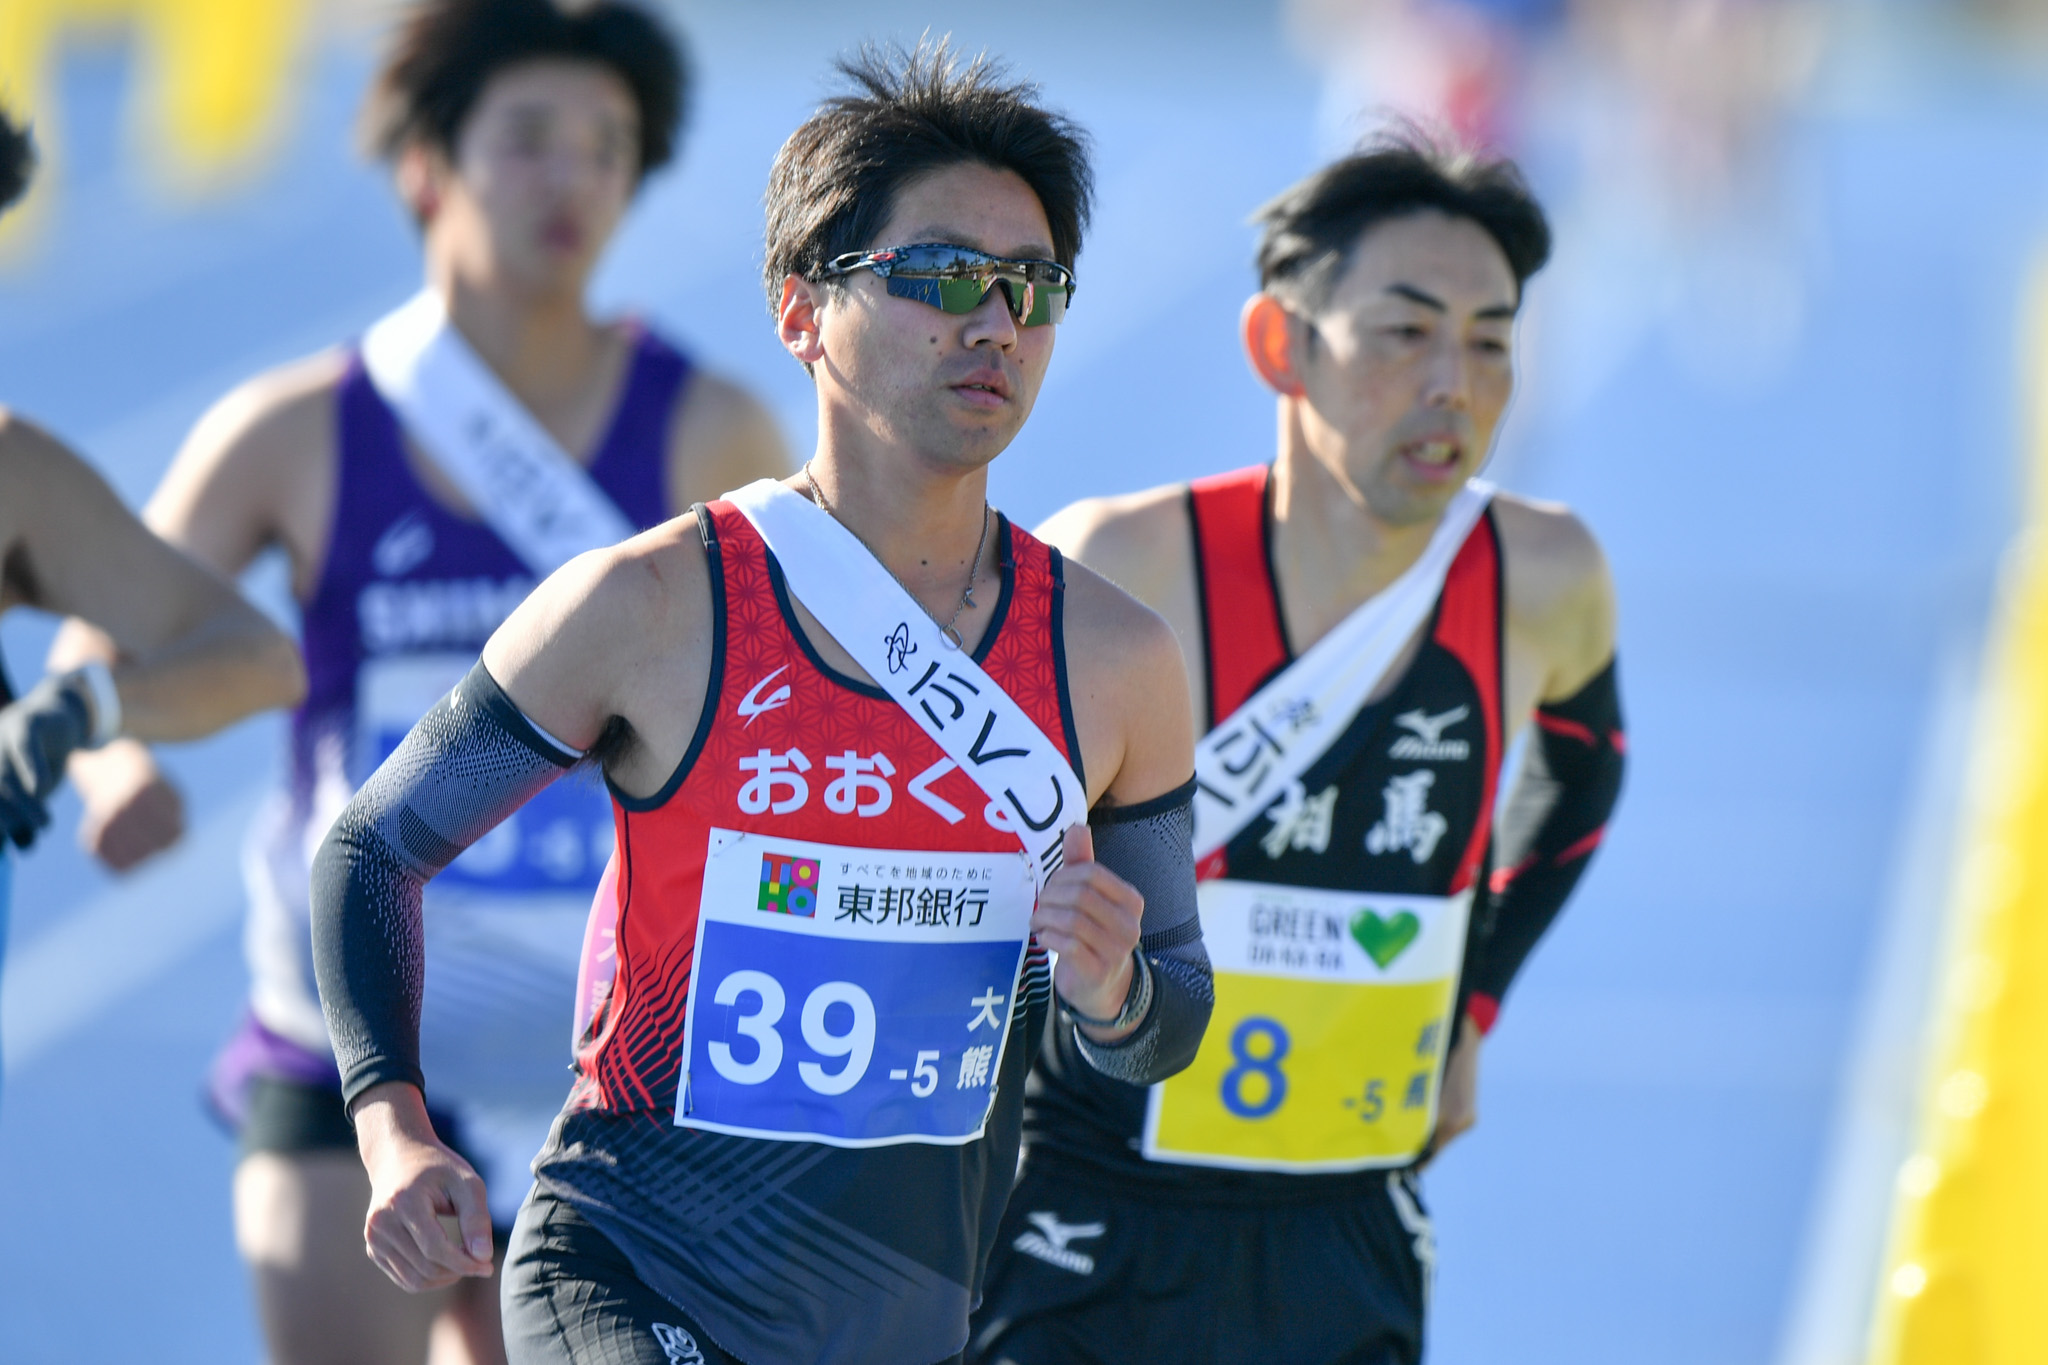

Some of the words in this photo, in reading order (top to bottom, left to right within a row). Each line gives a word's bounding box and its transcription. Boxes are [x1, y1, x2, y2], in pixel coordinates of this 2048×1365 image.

[834, 884, 990, 927] 東邦銀行
[839, 861, 993, 881] すべてを地域のために
[707, 969, 877, 1096] 39
[889, 1049, 940, 1098] -5
[956, 986, 1005, 1090] 大熊
[1218, 1015, 1292, 1121] 8
